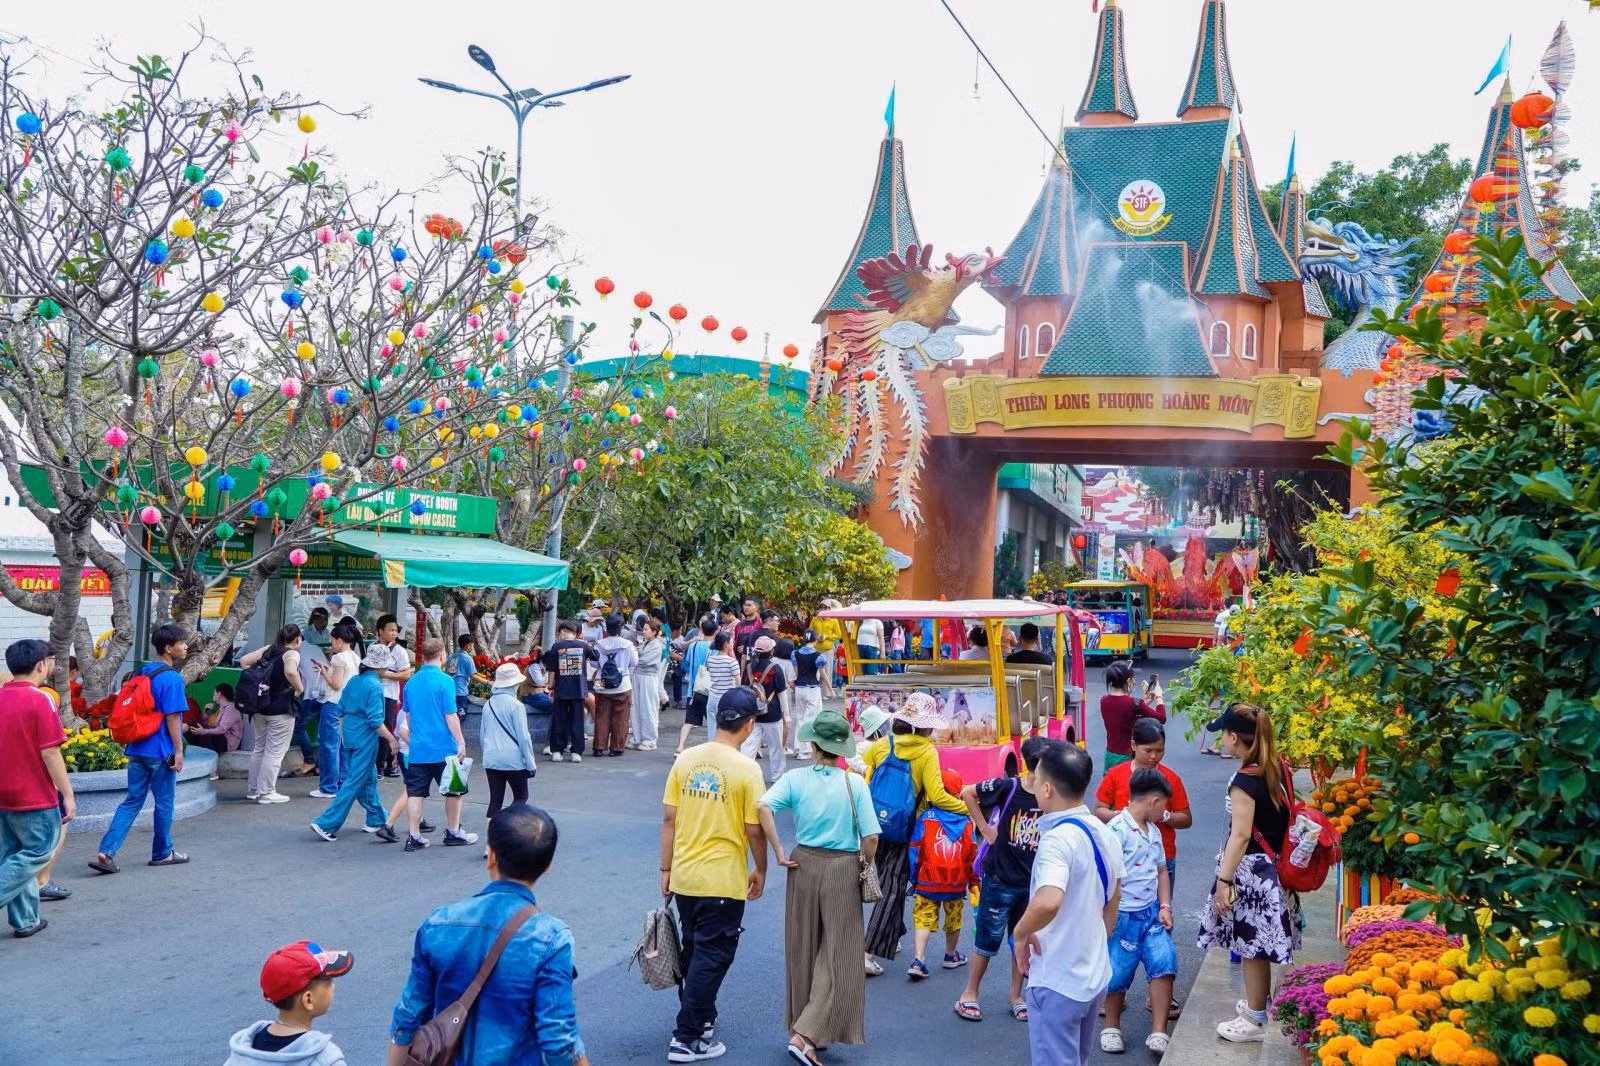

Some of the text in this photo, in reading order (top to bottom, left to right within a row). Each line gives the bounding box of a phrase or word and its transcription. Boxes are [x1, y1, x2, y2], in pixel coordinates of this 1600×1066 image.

[1134, 197, 1148, 209] STF
[1005, 392, 1252, 416] THIÊN LONG PHƯỢNG HOÀNG MÔN
[435, 496, 458, 511] BOOTH
[432, 513, 457, 528] CASTLE
